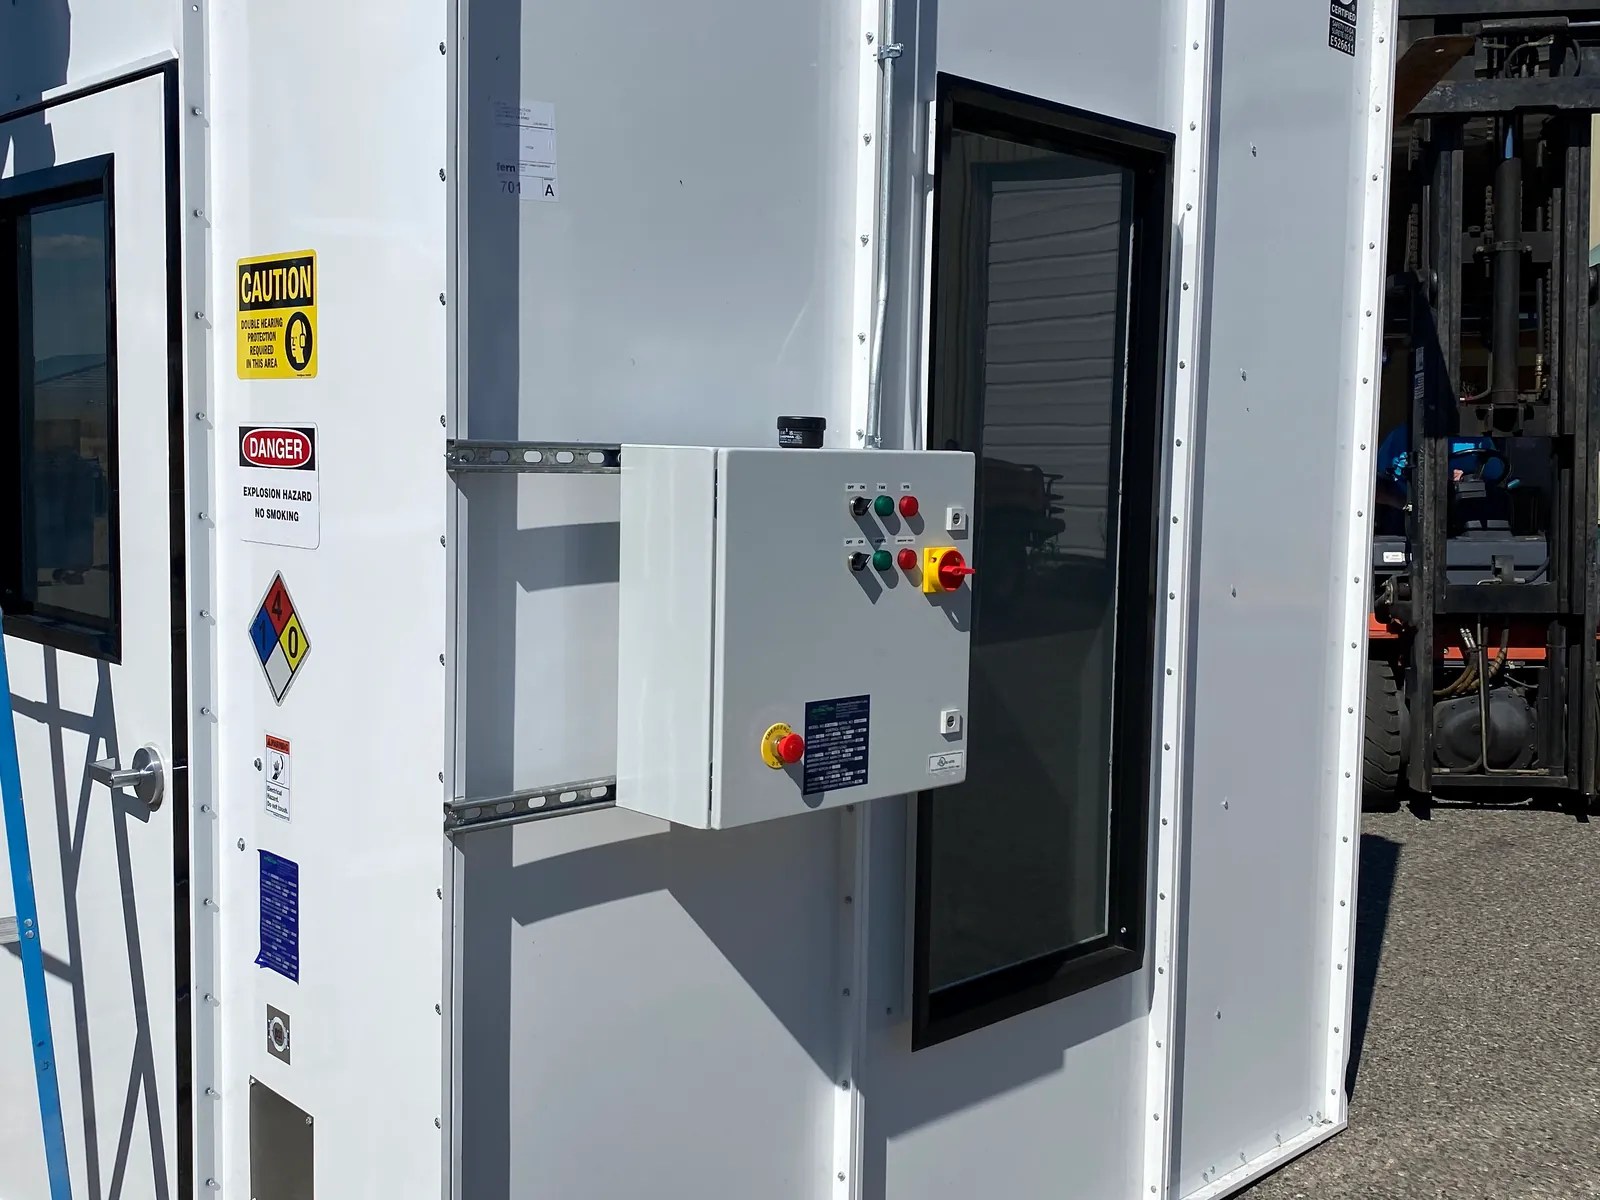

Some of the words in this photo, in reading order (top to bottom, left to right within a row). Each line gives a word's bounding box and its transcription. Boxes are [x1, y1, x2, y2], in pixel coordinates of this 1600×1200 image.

[1331, 4, 1356, 22] CERTIFIED
[1330, 35, 1354, 54] E526611
[545, 184, 555, 197] A
[241, 265, 311, 304] CAUTION
[241, 319, 260, 330] DOUBLE
[261, 317, 283, 329] HEARING
[247, 331, 276, 342] PROTECTION
[249, 345, 274, 356] REQUIRED
[246, 359, 252, 368] IN
[252, 359, 264, 369] THIS
[264, 358, 278, 368] AREA
[250, 437, 303, 460] DANGER
[243, 486, 281, 499] EXPLOSION
[282, 489, 312, 502] HAZARD
[254, 507, 265, 518] NO
[266, 508, 299, 522] SMOKING
[272, 590, 283, 621] 4
[259, 620, 267, 651] 1
[288, 626, 298, 659] 0
